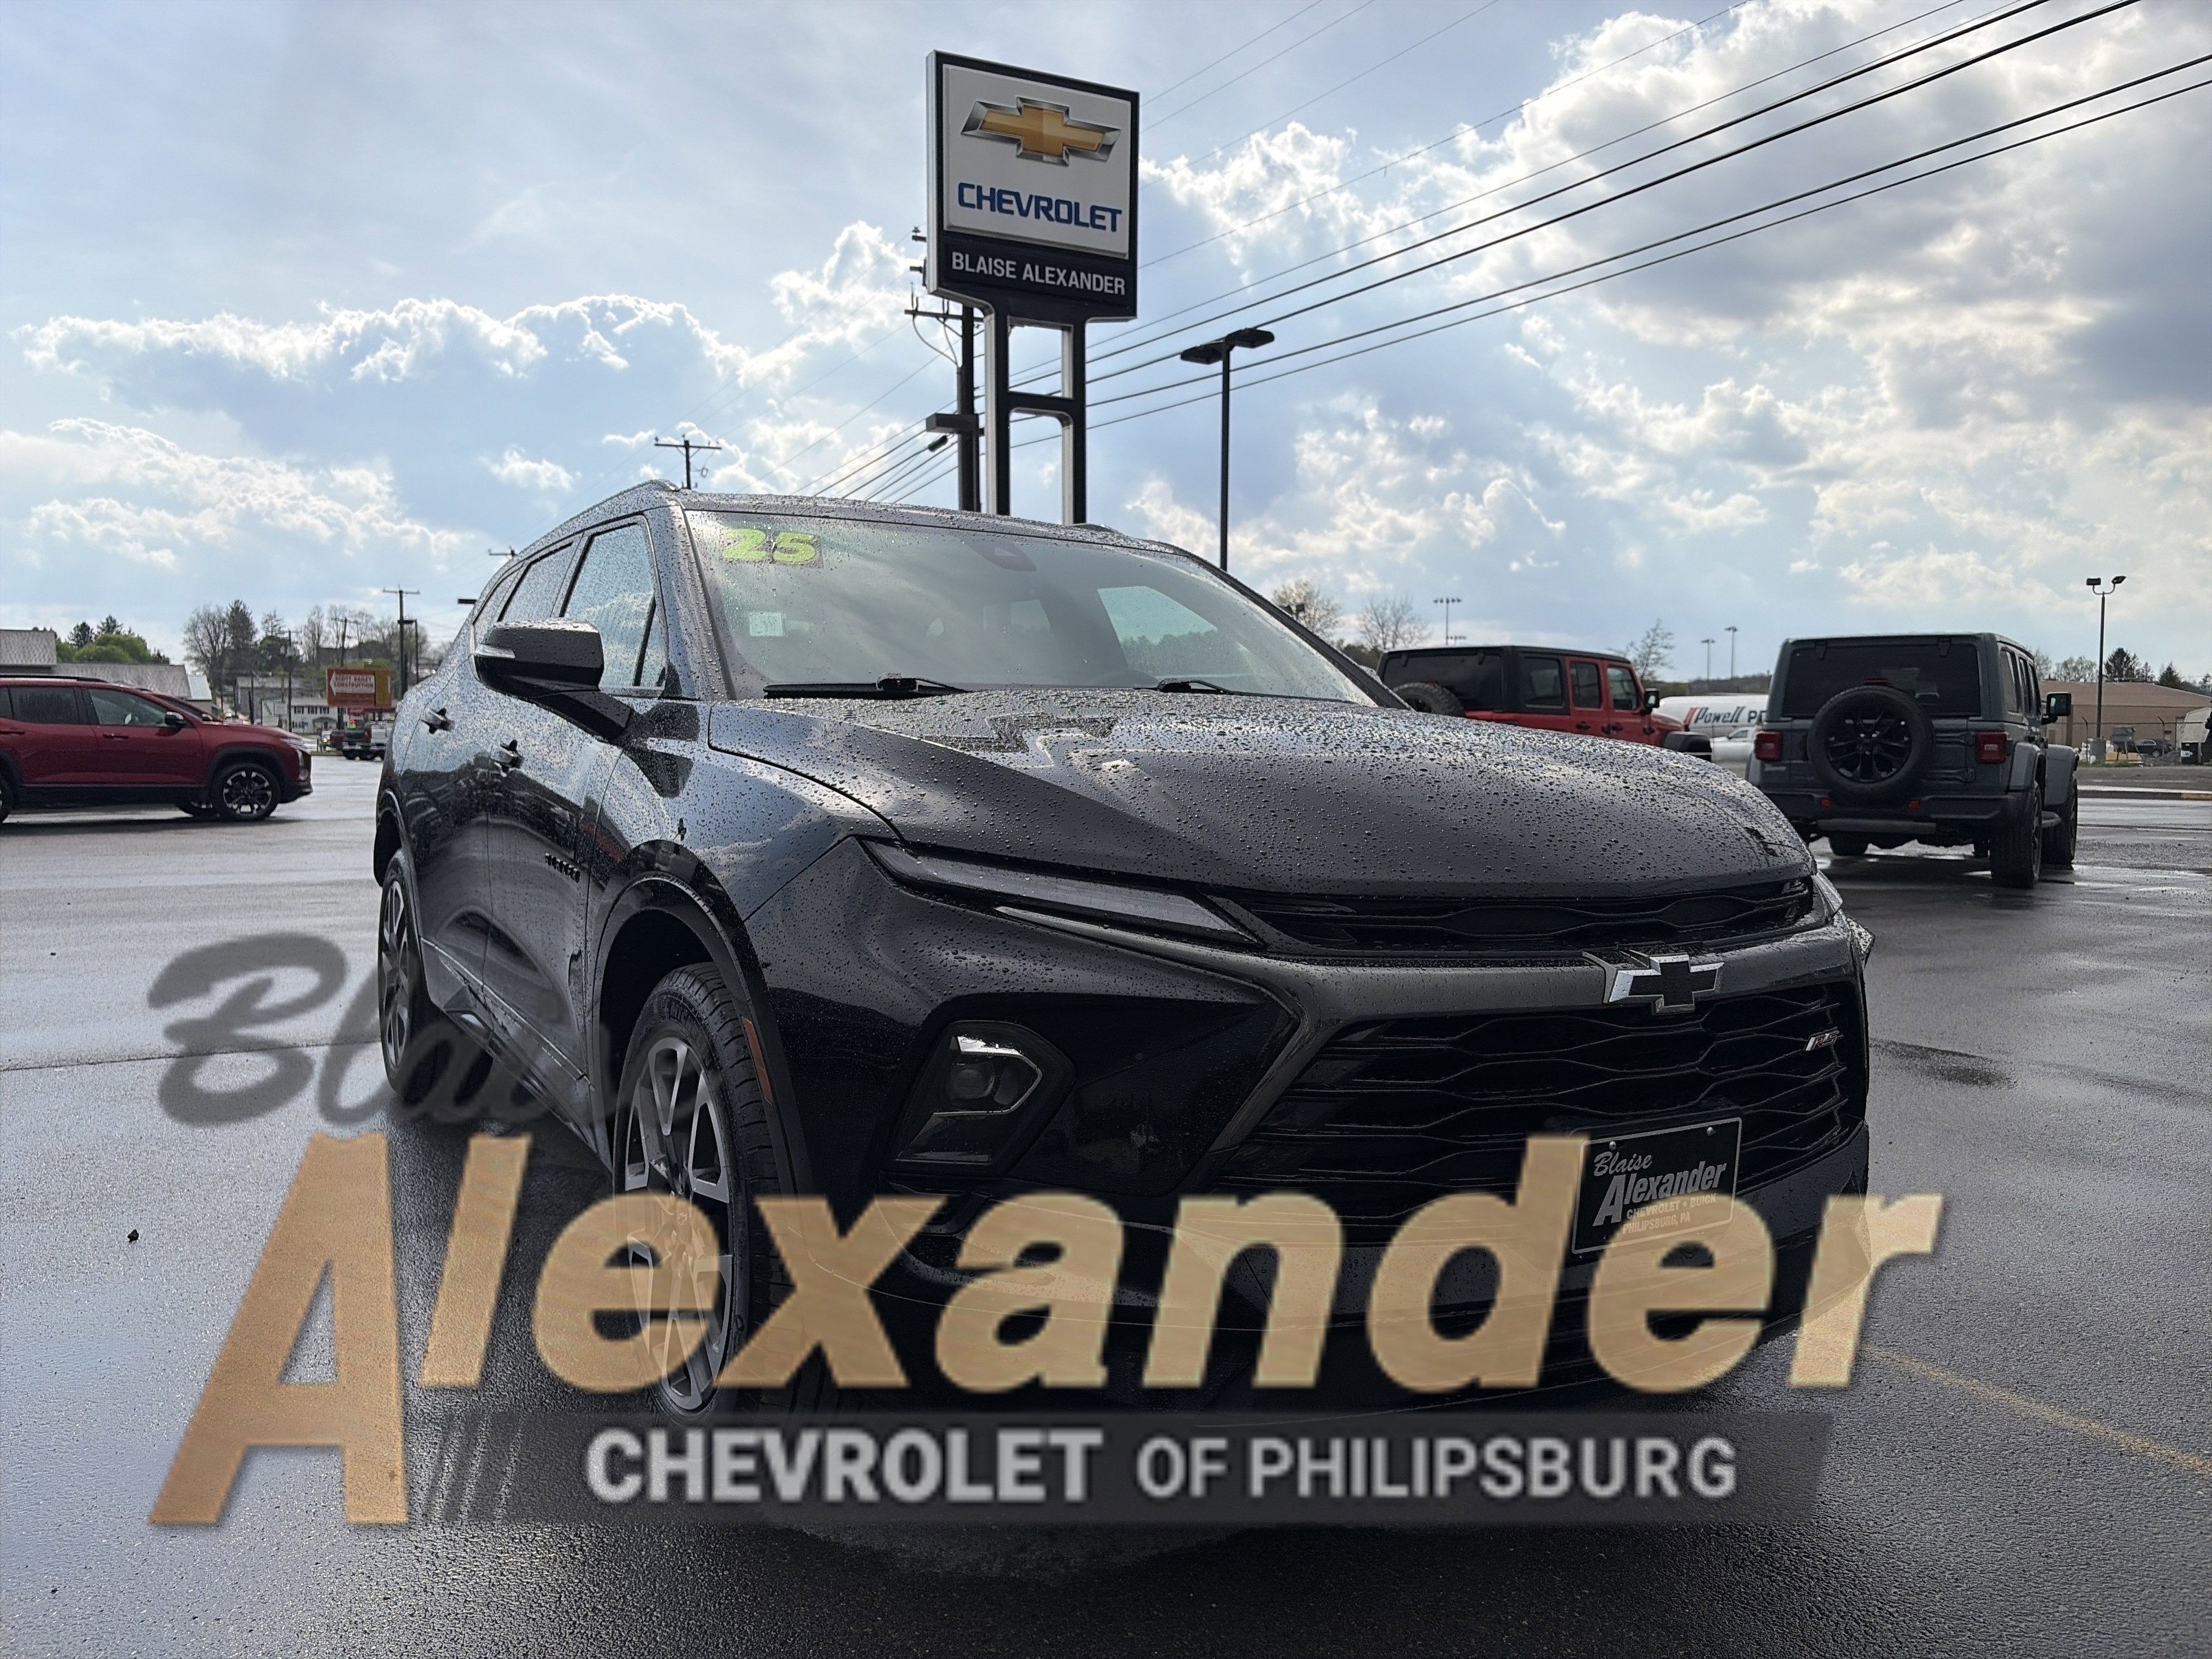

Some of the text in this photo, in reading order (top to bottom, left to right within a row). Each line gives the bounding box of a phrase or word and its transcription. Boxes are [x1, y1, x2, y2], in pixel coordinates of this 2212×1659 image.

[958, 182, 1122, 233] CHEVROLET
[952, 251, 1126, 296] BLAISE ALEXANDER
[723, 528, 817, 565] 25
[1694, 706, 1746, 724] Powell
[1593, 1151, 1652, 1177] Blaise
[1592, 1160, 1728, 1227] Alexander
[1626, 1192, 1718, 1220] CHEVROLET BUICK
[1679, 1211, 1691, 1224] PA
